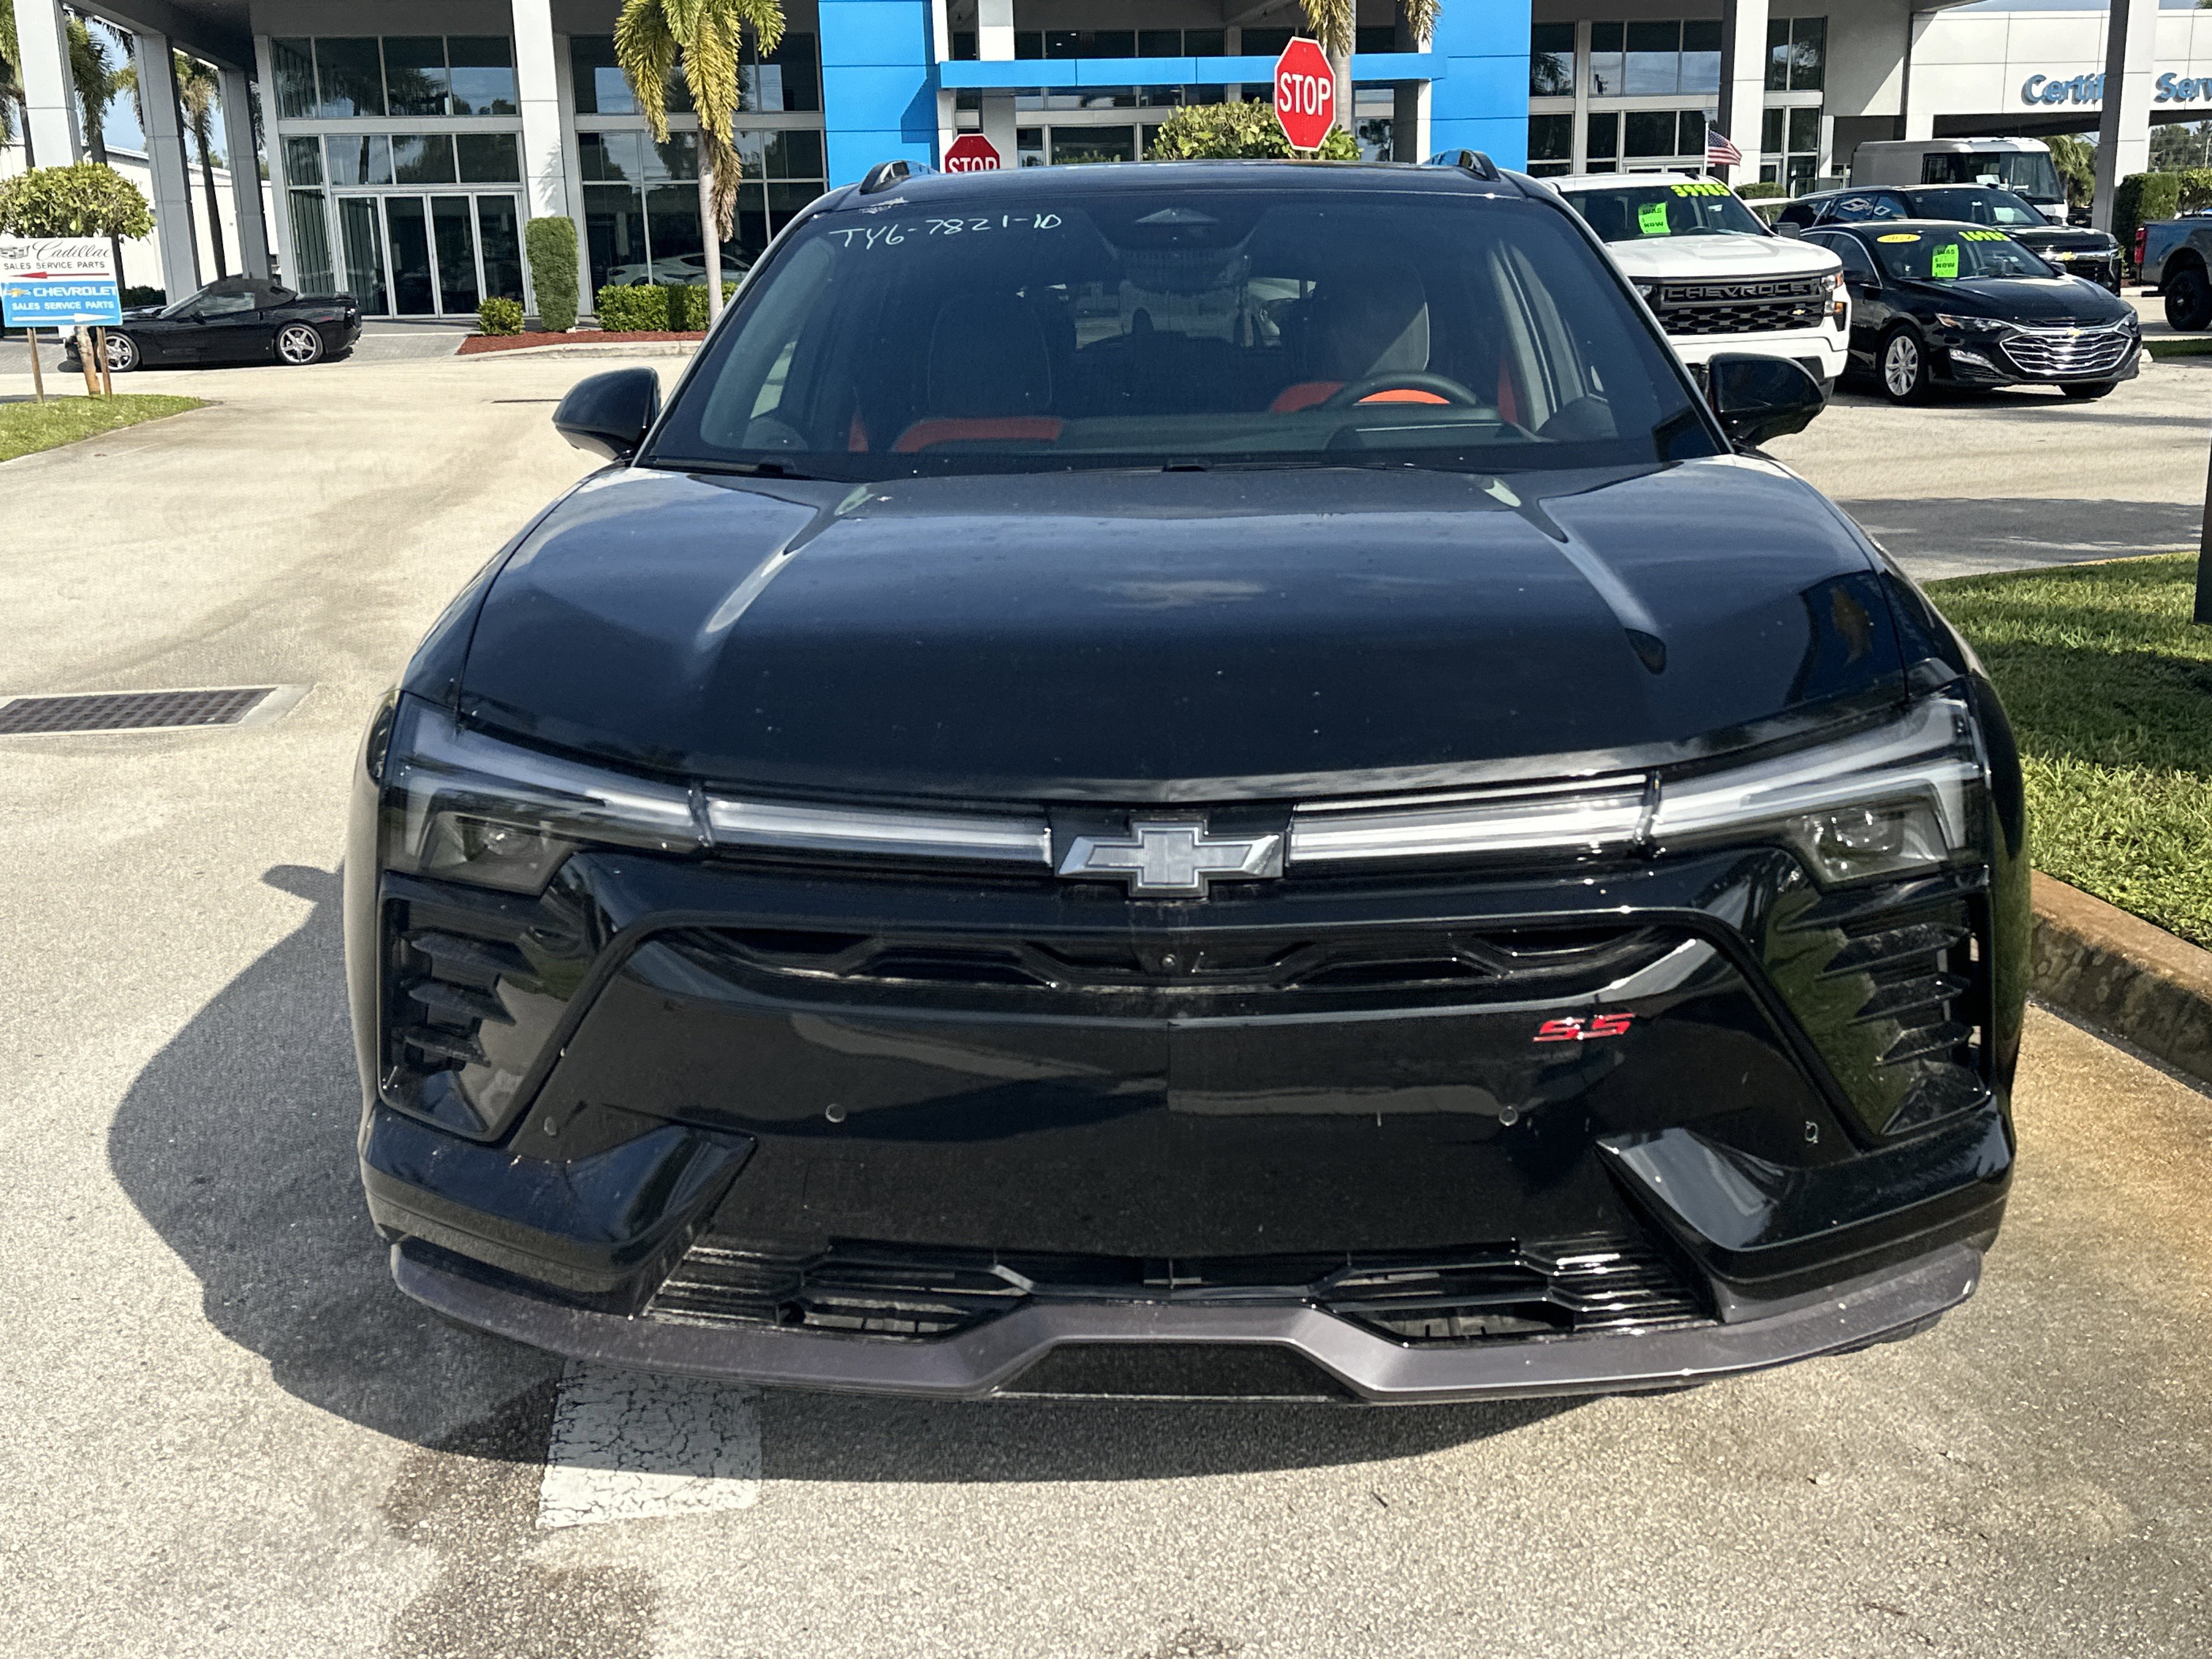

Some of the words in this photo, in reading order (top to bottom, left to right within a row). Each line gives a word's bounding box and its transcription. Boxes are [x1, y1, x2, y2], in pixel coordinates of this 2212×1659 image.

[1279, 72, 1331, 116] STOP
[949, 156, 997, 173] STOP
[32, 239, 111, 261] Cadillac
[33, 286, 118, 297] CHEVROLET
[12, 302, 40, 311] SALES
[86, 301, 114, 309] PARTS
[1533, 1013, 1635, 1042] SS
